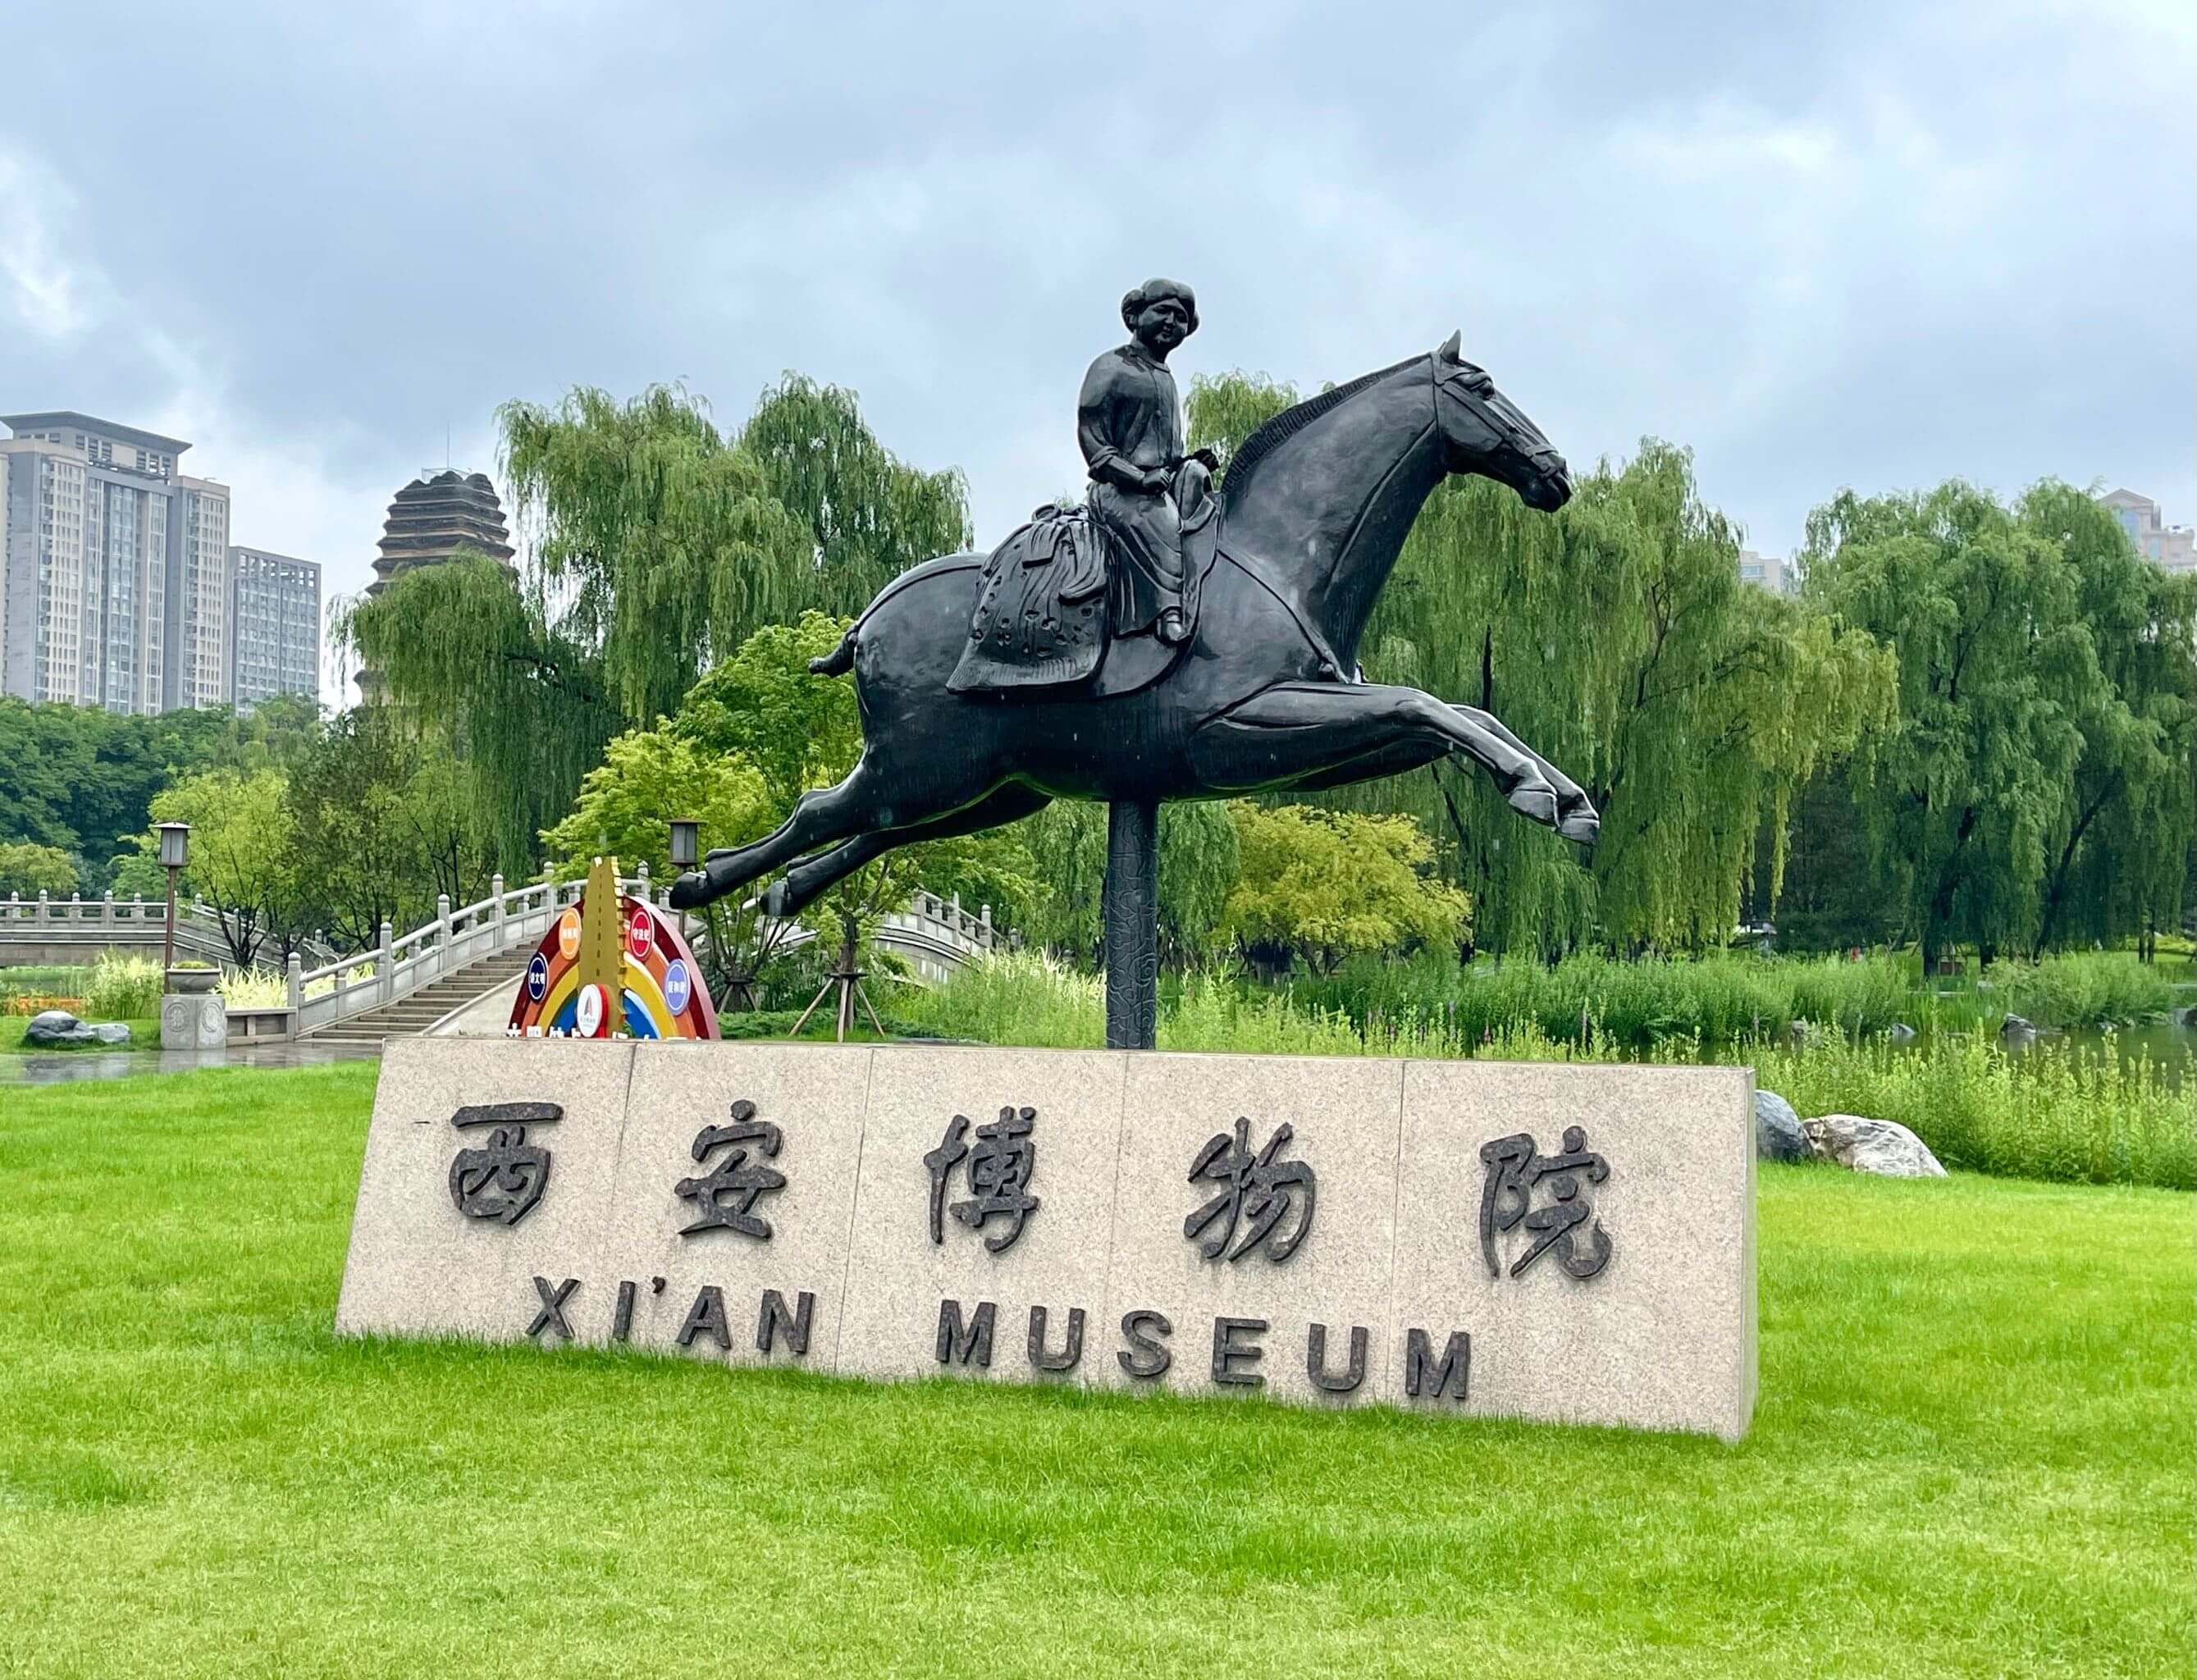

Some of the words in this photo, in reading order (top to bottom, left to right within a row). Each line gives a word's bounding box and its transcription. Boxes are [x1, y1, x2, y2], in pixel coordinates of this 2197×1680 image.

[448, 1098, 1613, 1281] 西安博物院
[525, 1276, 816, 1355] XI'AN
[935, 1298, 1470, 1399] MUSEUM
